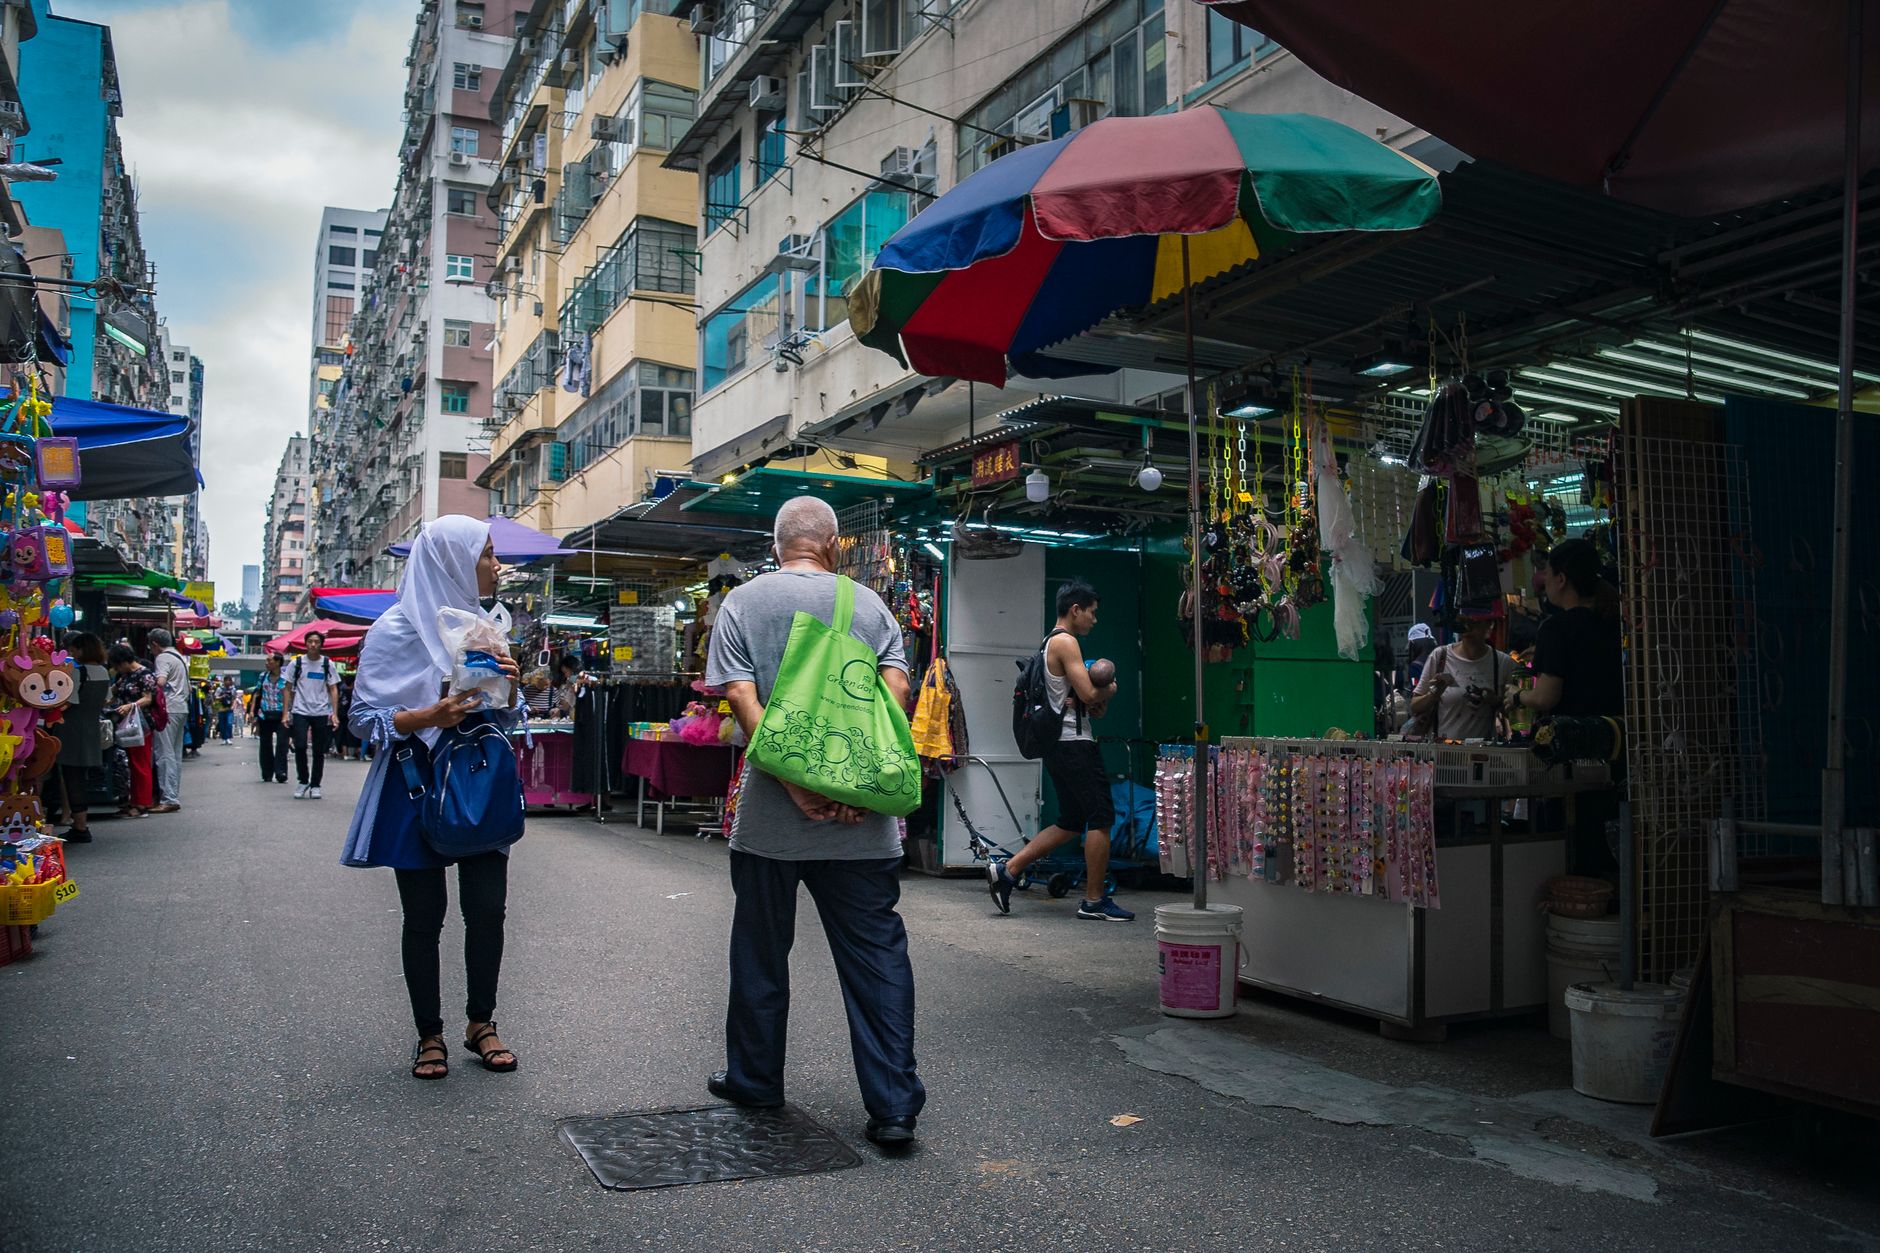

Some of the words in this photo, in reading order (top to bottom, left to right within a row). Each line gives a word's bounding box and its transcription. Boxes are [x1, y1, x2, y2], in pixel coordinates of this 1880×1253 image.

[827, 674, 855, 687] Green
[857, 682, 872, 694] dot
[55, 883, 77, 901] $10
